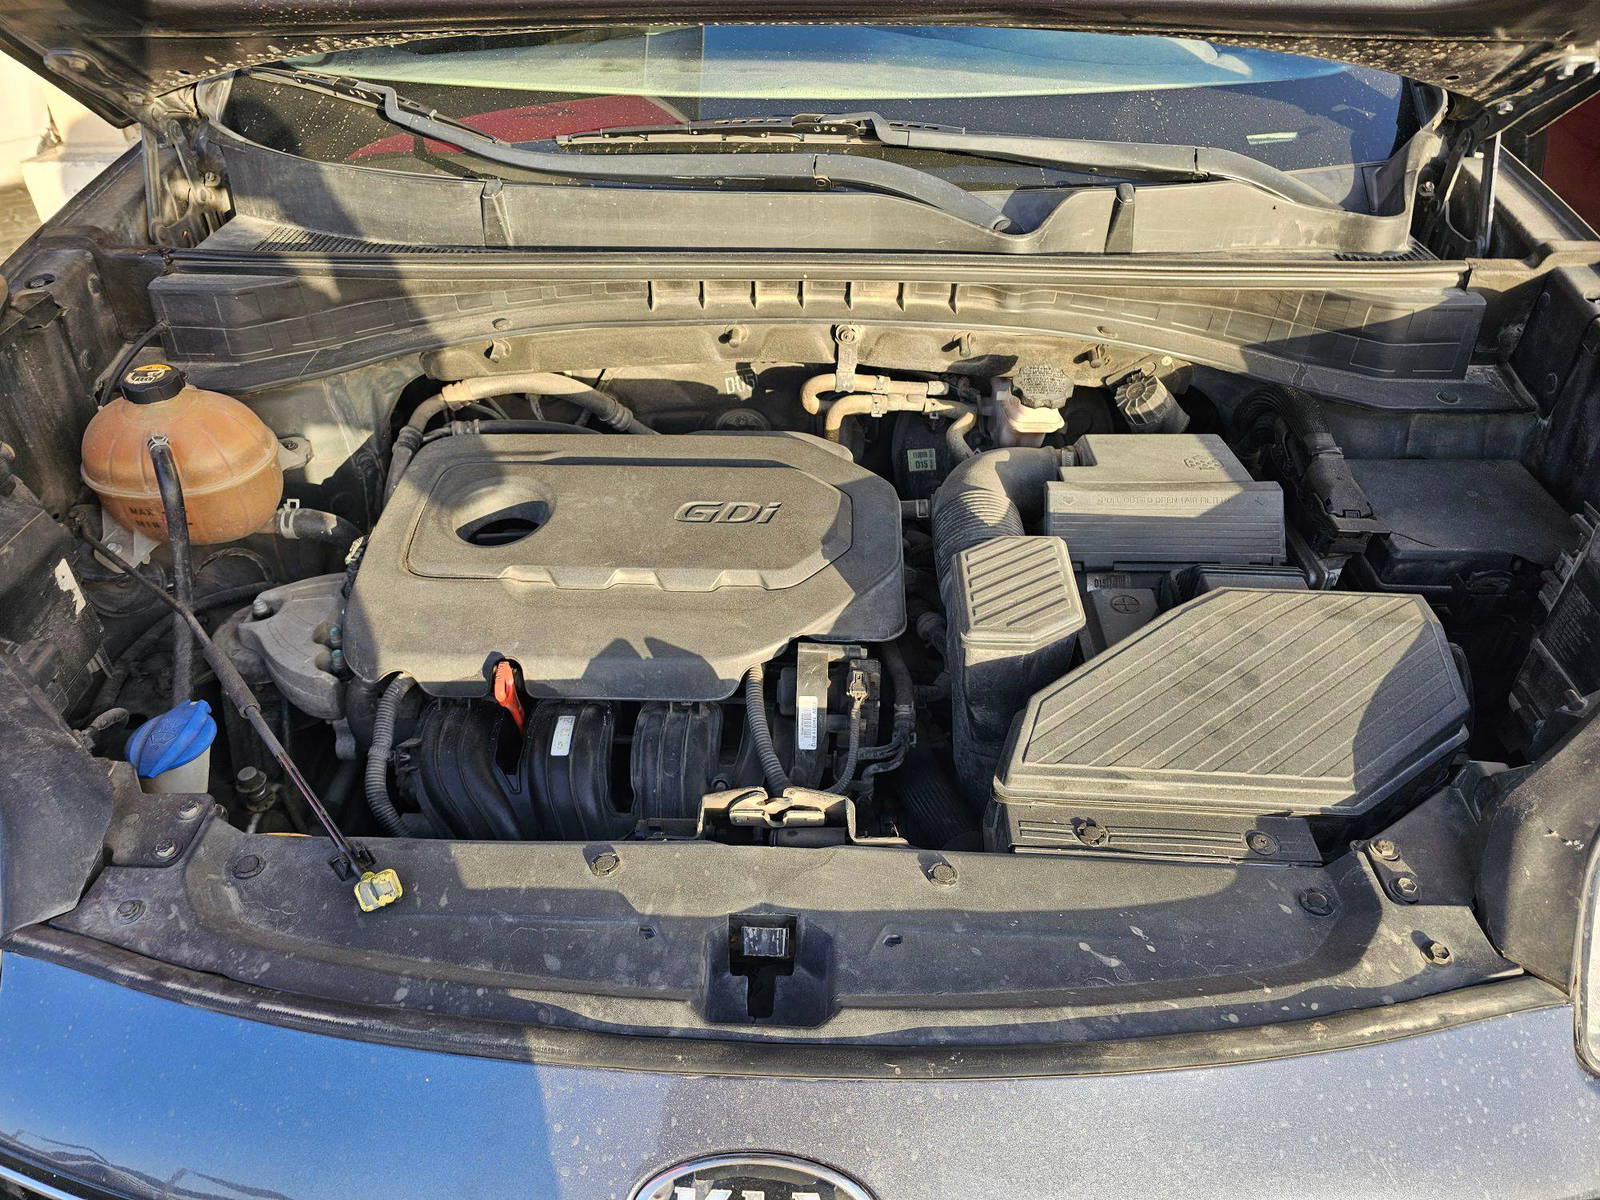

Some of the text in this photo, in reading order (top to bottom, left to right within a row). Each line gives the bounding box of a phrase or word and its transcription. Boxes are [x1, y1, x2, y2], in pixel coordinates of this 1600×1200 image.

[129, 507, 154, 516] MAX
[673, 500, 783, 524] GDi
[135, 520, 161, 529] MIN
